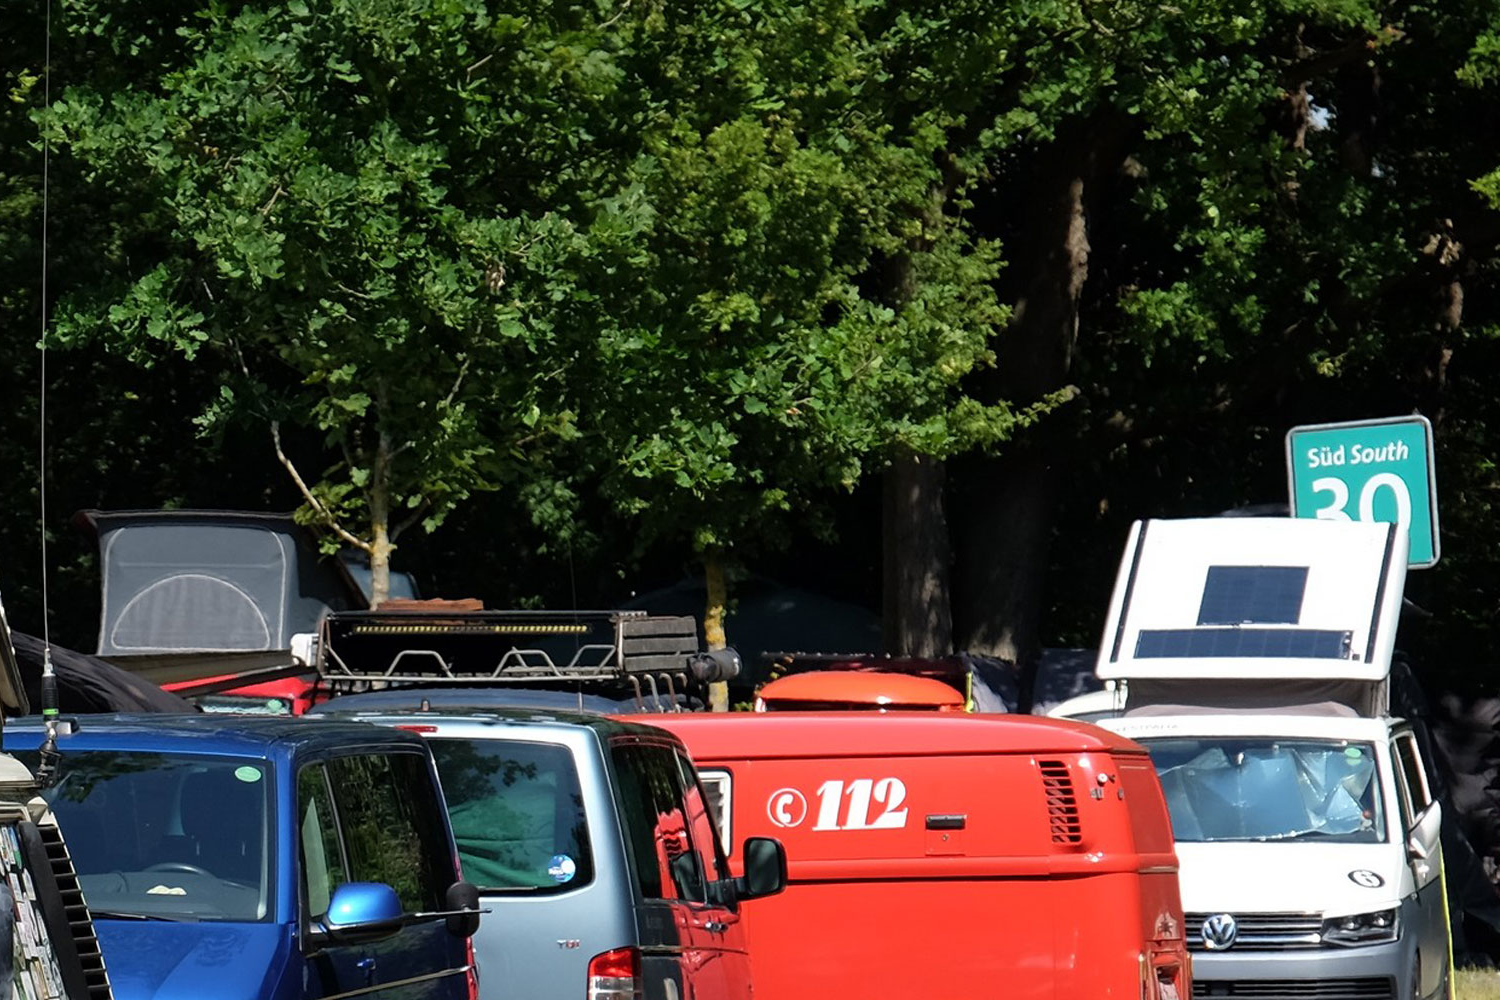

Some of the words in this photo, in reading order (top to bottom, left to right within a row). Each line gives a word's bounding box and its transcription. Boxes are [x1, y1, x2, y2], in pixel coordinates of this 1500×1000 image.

[1308, 444, 1345, 468] Süd
[1351, 440, 1409, 464] South
[1312, 472, 1412, 532] 30
[812, 777, 908, 831] 112
